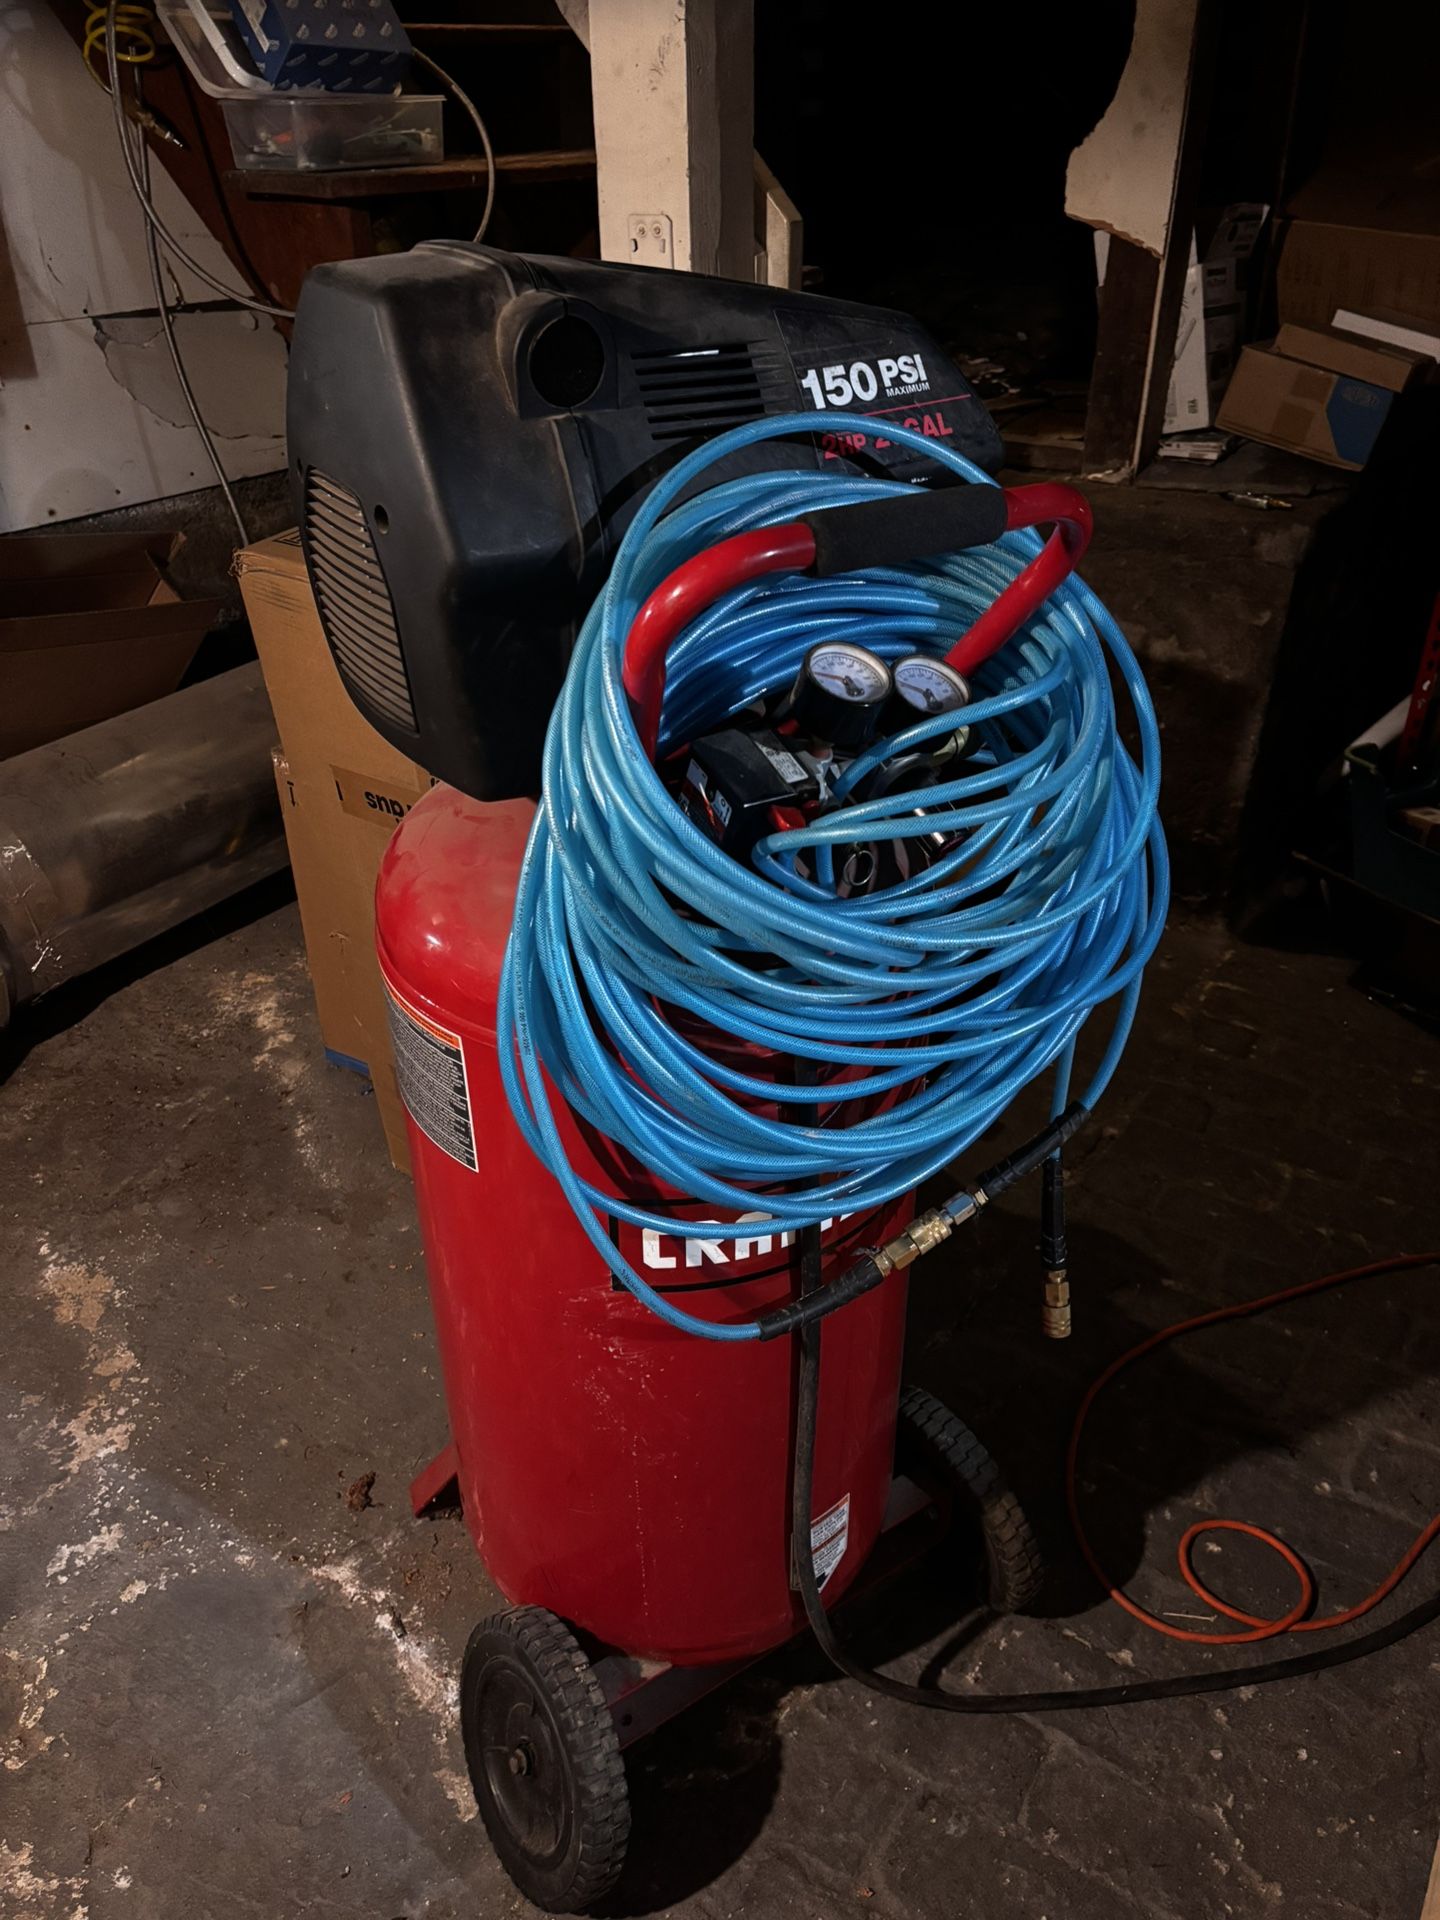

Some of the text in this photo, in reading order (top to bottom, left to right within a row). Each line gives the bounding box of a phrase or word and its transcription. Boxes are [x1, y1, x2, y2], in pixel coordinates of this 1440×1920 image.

[802, 354, 927, 409] 150 PSI
[886, 382, 930, 397] MAXIMUM
